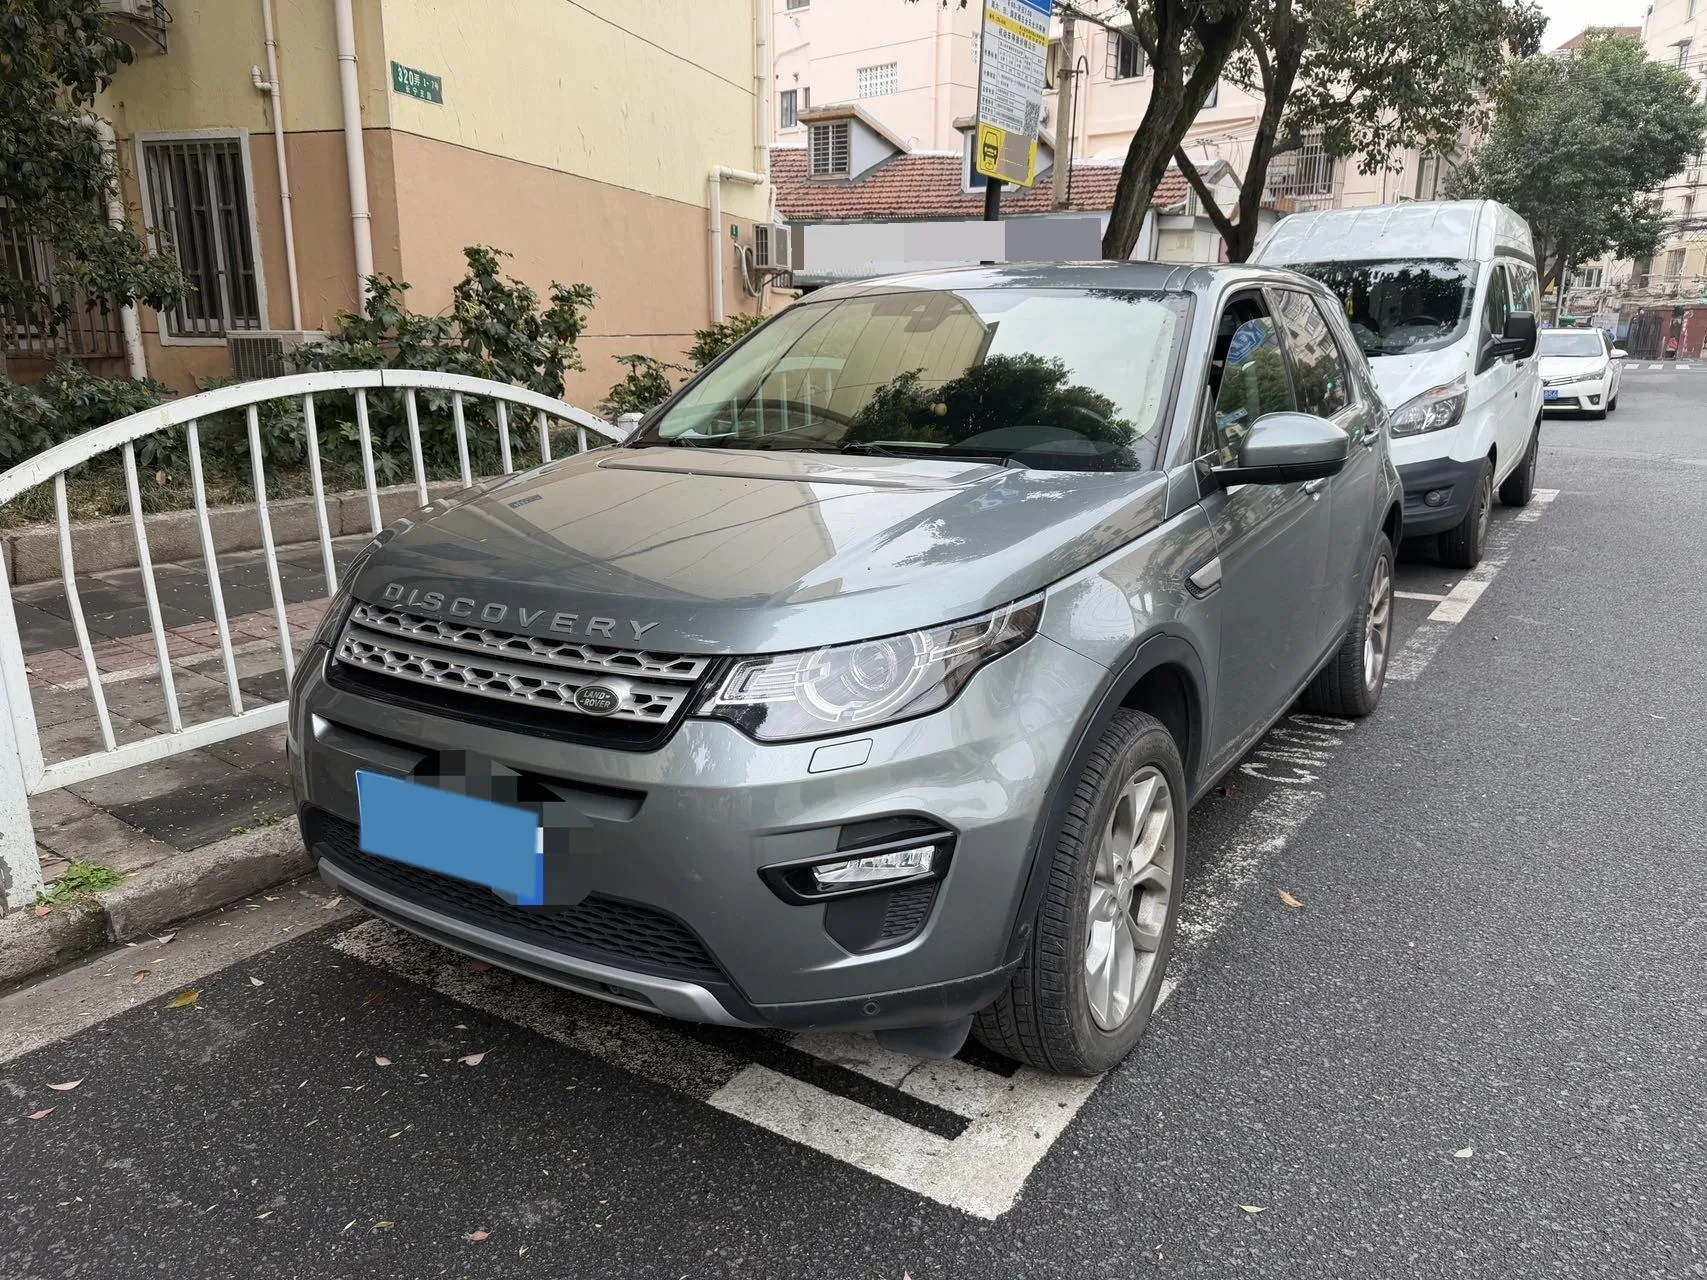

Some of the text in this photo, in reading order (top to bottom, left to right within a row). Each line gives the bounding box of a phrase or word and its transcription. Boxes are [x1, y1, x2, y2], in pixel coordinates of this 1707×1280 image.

[382, 582, 660, 641] DISCOVERY
[583, 690, 606, 700] LAND
[583, 698, 611, 708] ROVER
